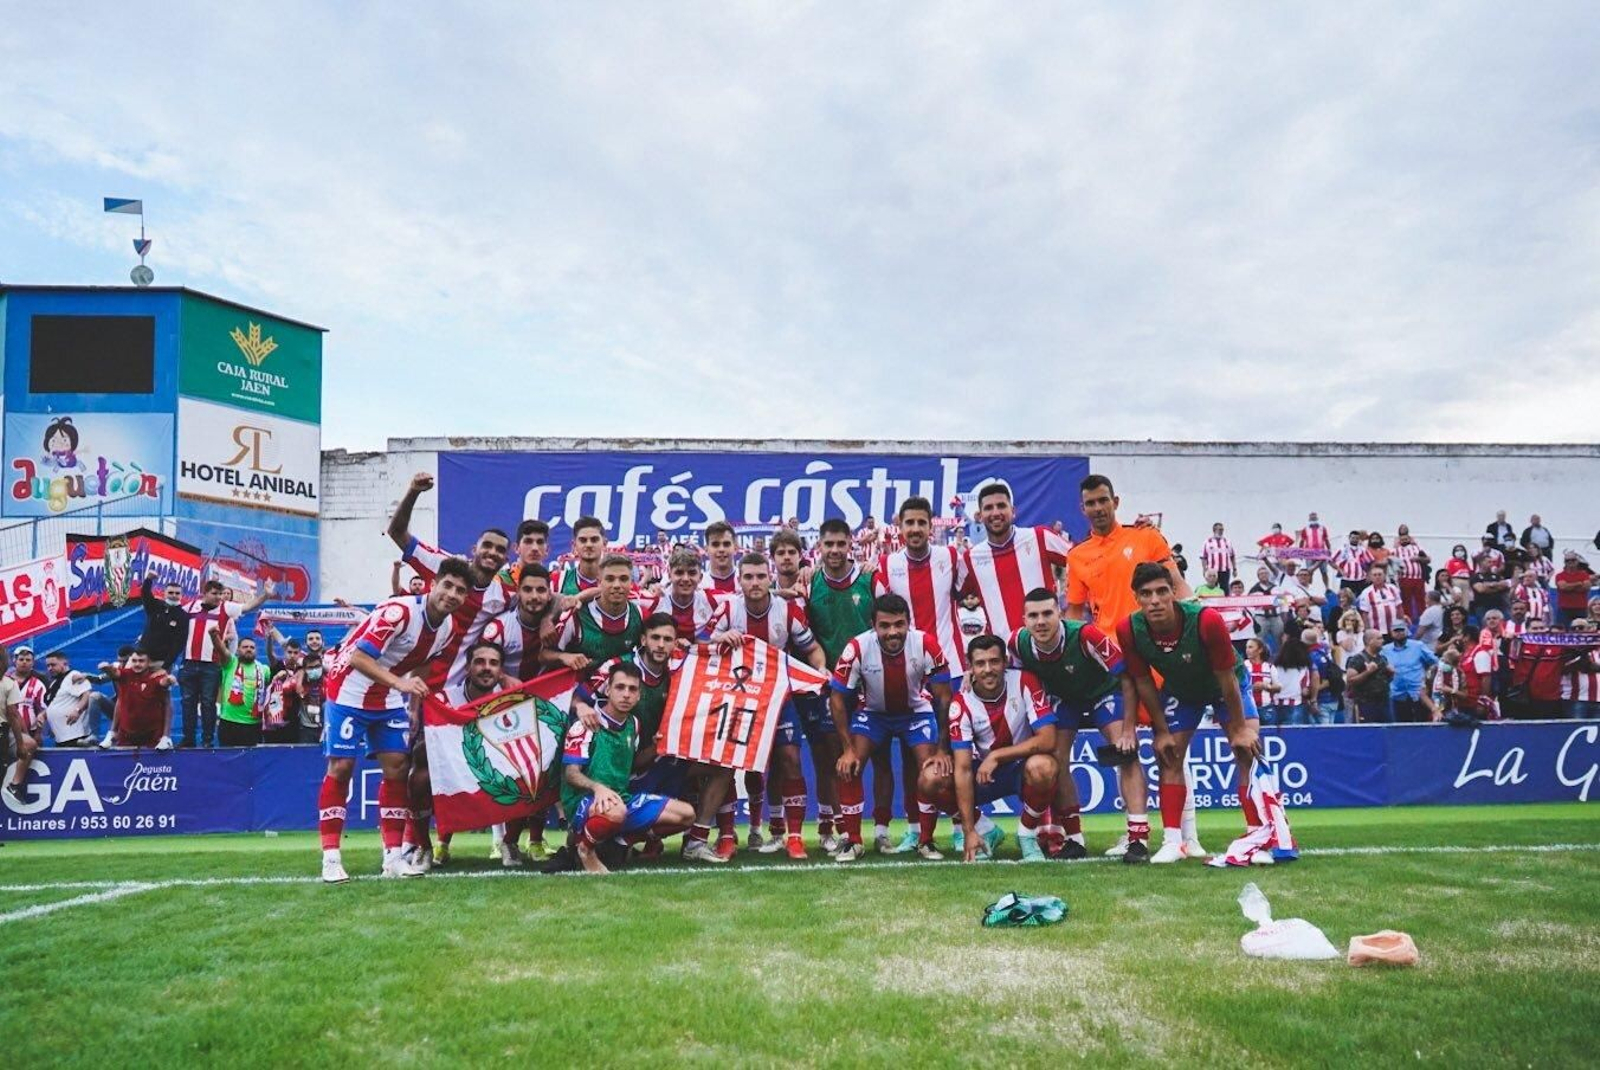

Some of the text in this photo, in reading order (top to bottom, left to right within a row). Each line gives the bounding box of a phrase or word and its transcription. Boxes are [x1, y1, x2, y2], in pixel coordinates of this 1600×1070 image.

[217, 361, 289, 388] CAJA RURAL
[240, 379, 271, 396] JAEN
[181, 461, 317, 499] HOTEL ANIBAL
[523, 465, 725, 546] cafés
[340, 716, 354, 740] 6
[1137, 736, 1287, 764] CLIDD
[1453, 726, 1600, 802] La G
[1293, 793, 1313, 806] 04
[8, 817, 66, 831] Linares
[80, 815, 108, 829] 953
[113, 815, 131, 829] 60
[135, 814, 153, 829] 26
[158, 814, 176, 828] 91
